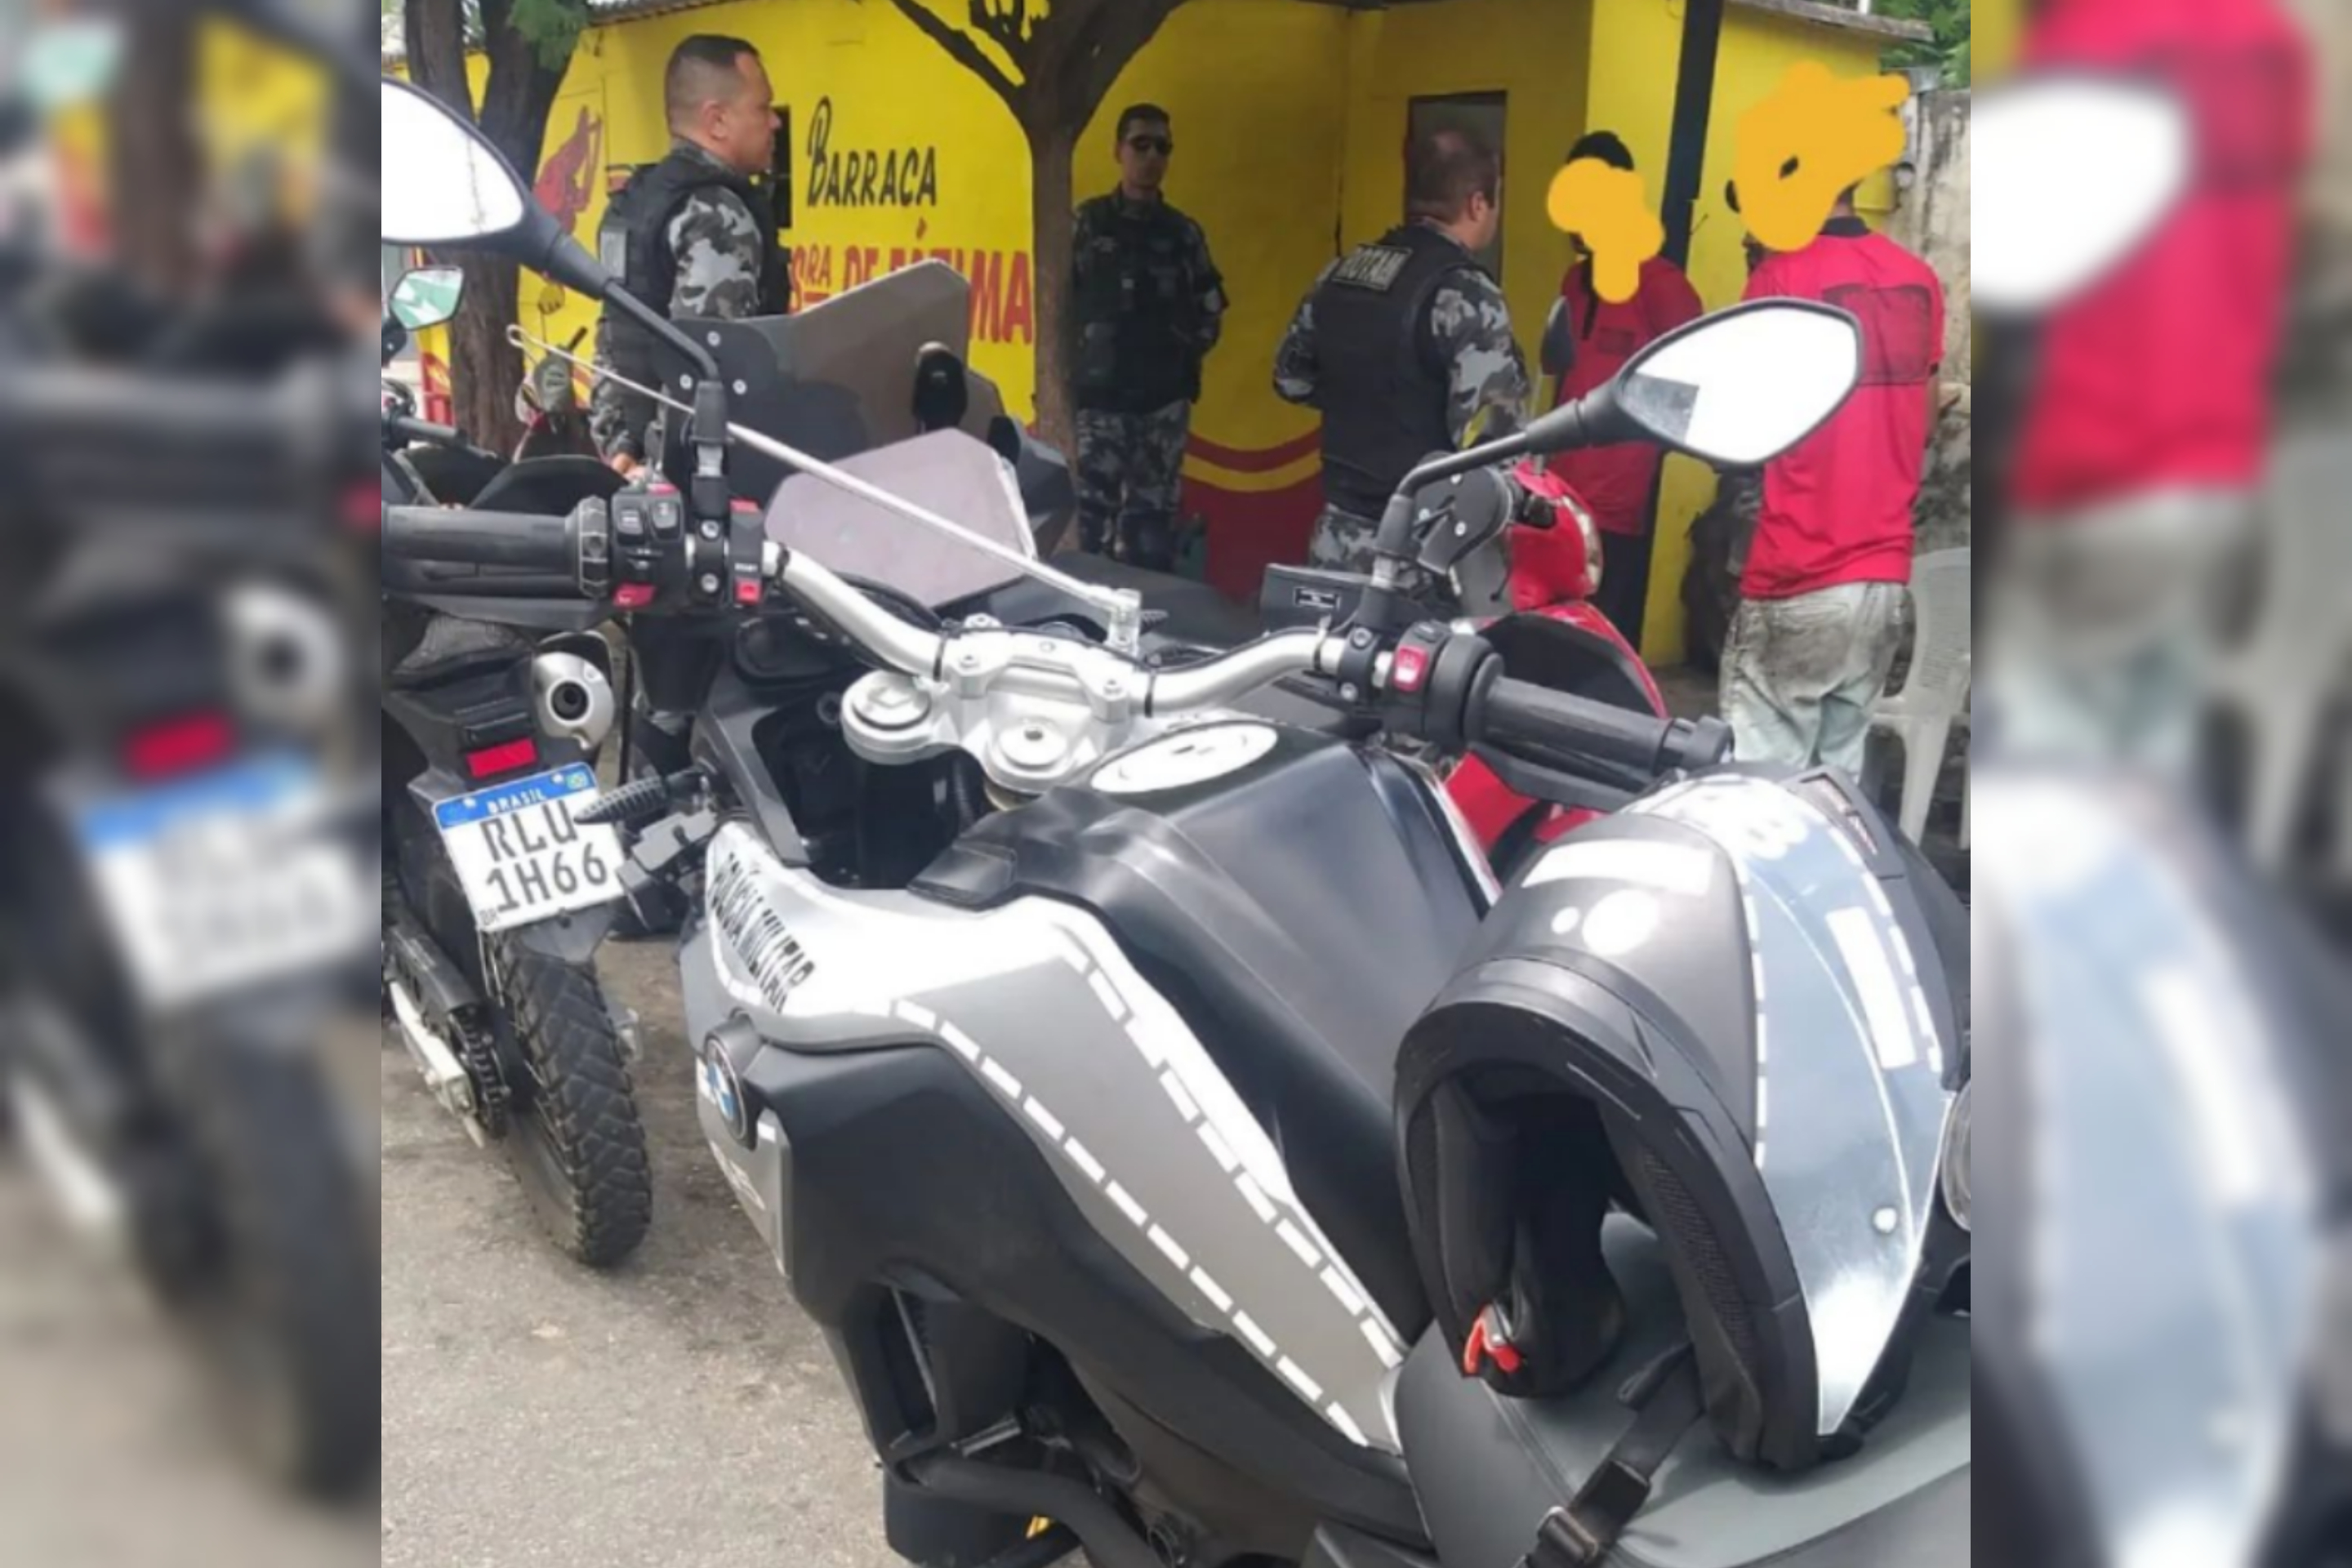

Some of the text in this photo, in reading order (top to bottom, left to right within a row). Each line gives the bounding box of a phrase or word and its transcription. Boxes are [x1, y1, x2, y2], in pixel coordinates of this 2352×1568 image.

[479, 800, 578, 862] RLU
[487, 787, 546, 815] BRASIL
[486, 842, 608, 913] 1H66
